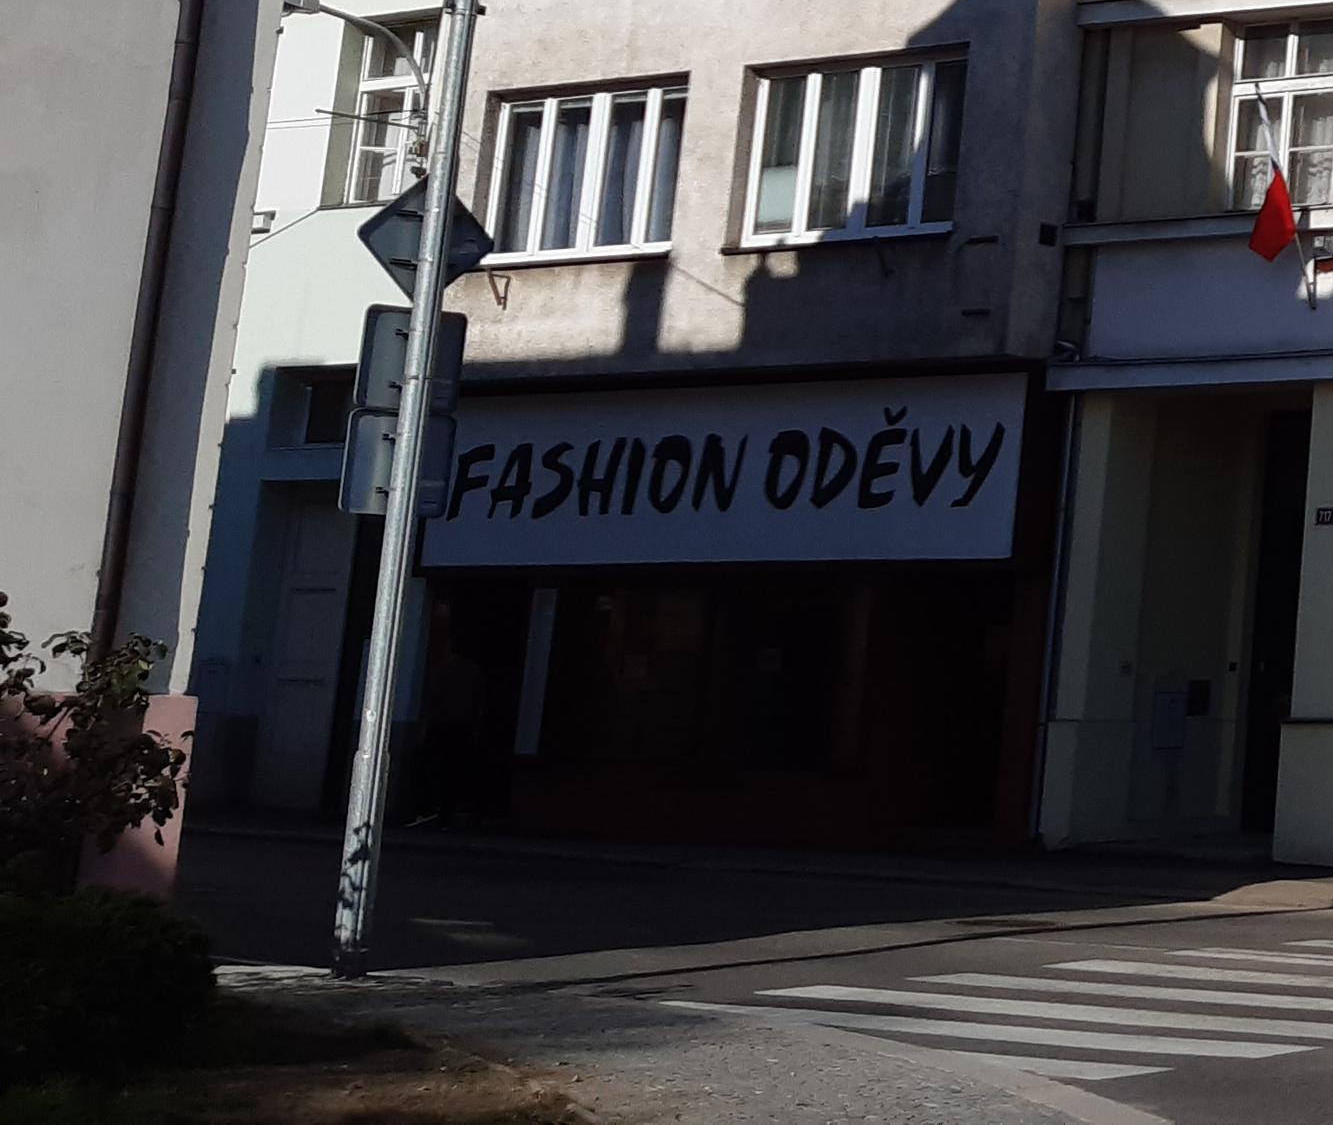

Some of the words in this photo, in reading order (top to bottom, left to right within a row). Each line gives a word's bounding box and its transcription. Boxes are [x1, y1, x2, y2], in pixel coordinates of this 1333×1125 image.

[447, 431, 748, 521] FASHION
[764, 405, 1006, 510] ODĚVY
[1318, 510, 1332, 522] 717
